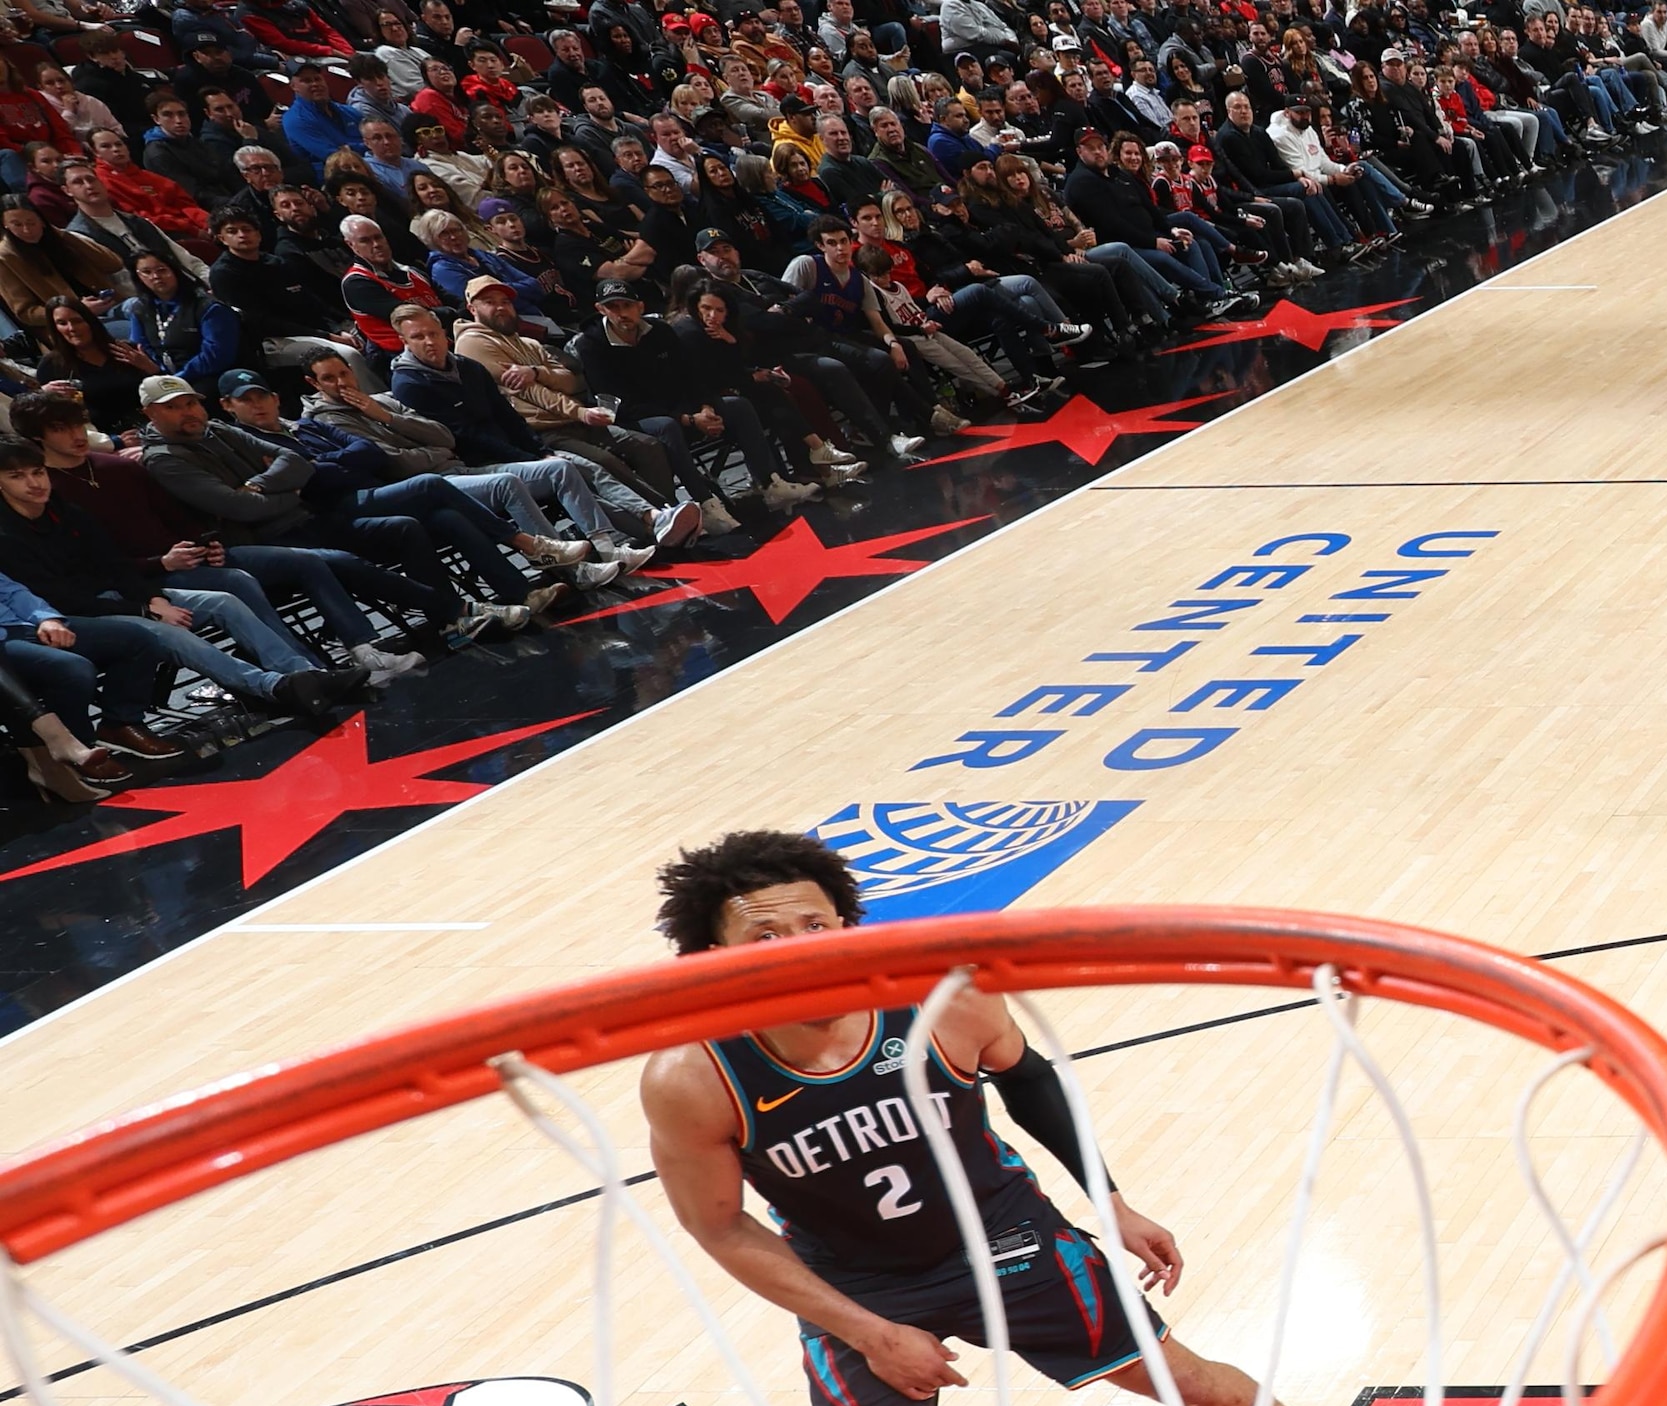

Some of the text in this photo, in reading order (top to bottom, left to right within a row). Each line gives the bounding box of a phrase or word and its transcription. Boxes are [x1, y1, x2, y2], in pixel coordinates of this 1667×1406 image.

[906, 533, 1352, 772] CENTER
[1104, 531, 1502, 771] UNITED
[863, 1164, 923, 1221] 2
